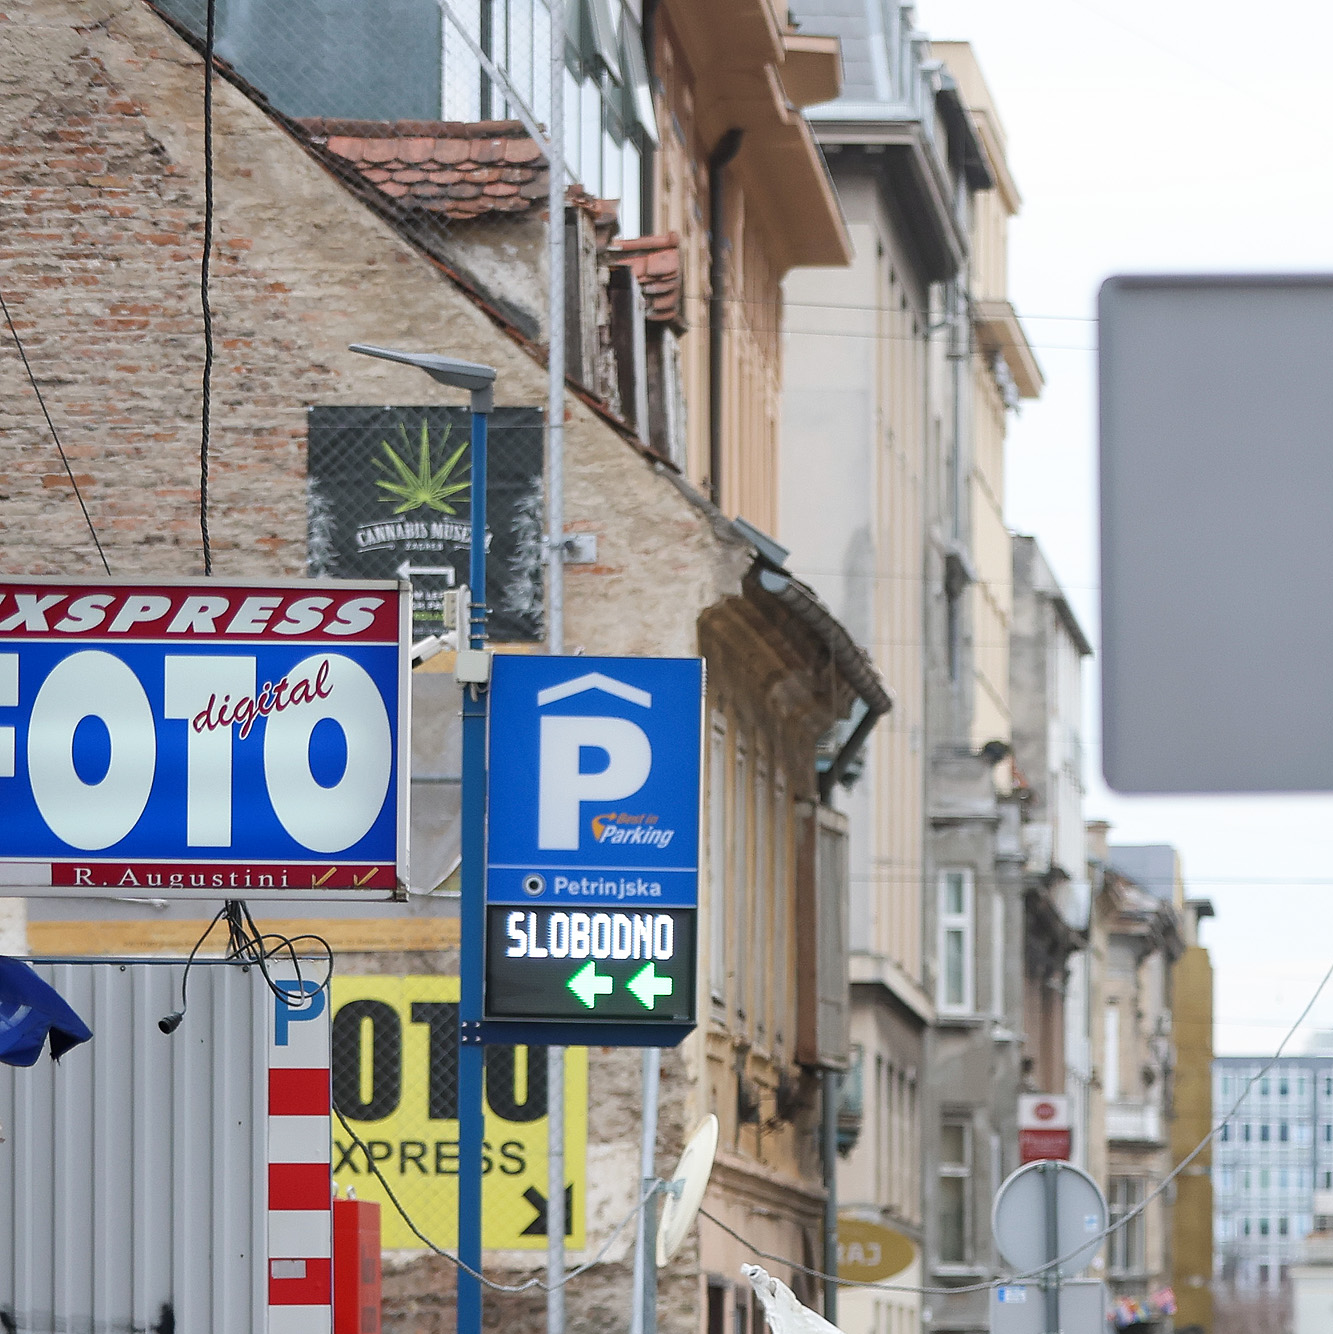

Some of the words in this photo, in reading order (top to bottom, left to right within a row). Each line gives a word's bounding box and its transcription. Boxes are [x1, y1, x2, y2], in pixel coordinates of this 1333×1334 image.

[355, 522, 429, 548] CANNABIS
[431, 522, 493, 549] MUSE
[0, 594, 385, 635] XSPRESS
[193, 660, 334, 738] digital
[538, 716, 652, 850] P
[599, 825, 675, 848] Parking
[119, 867, 289, 889] Augustini
[554, 876, 662, 899] Petrinjska
[506, 911, 675, 960] SLOBODNO
[274, 980, 326, 1046] P
[332, 1000, 549, 1122] OTO
[334, 1141, 527, 1176] XPRES
